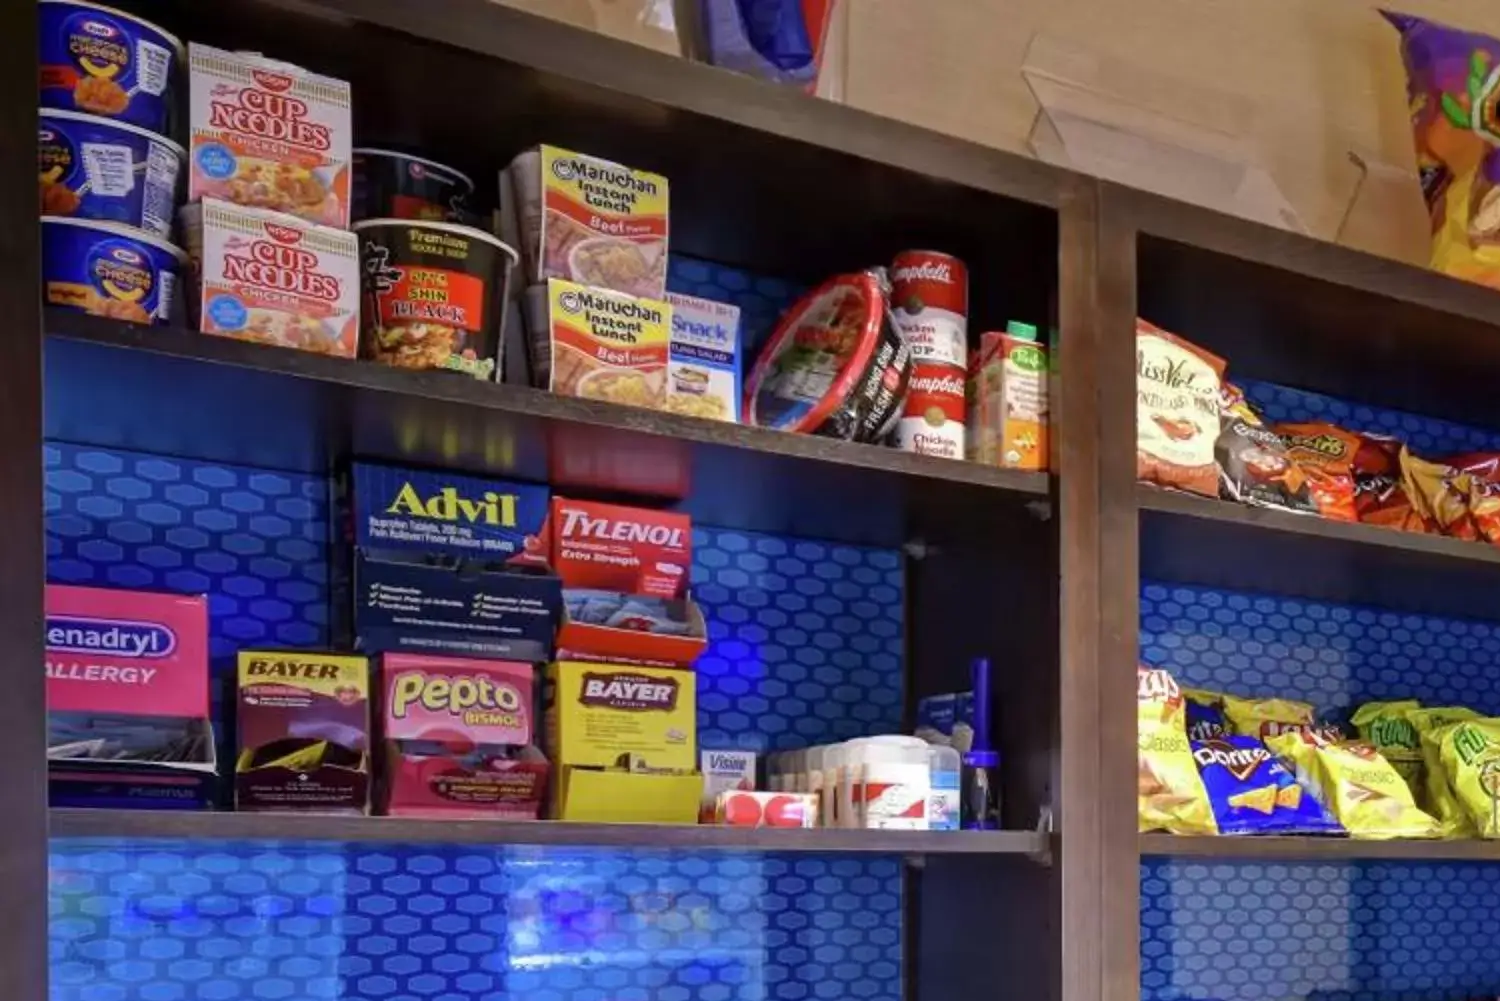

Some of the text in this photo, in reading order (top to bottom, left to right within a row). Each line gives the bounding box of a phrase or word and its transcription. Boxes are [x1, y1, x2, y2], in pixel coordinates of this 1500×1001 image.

[239, 88, 307, 120] CUP
[210, 102, 331, 151] NOODLES
[571, 160, 657, 195] Maruchan
[578, 180, 637, 204] Instant
[585, 195, 631, 215] Lunch
[590, 216, 624, 233] Beef
[252, 240, 318, 269] CUP
[223, 254, 340, 301] NOODLES
[408, 287, 447, 302] SHIN
[391, 300, 467, 323] BLACK
[577, 292, 661, 324] Maruchan
[584, 311, 643, 333] Instant
[592, 326, 637, 344] Lunch
[596, 347, 630, 365] Beef
[913, 434, 958, 447] Chicken
[386, 481, 519, 528] Advil
[560, 509, 684, 548] TYLENOL
[48, 626, 159, 655] enadryl
[247, 659, 341, 680] BAYER
[392, 672, 521, 720] Pepto
[583, 679, 674, 702] BAYER
